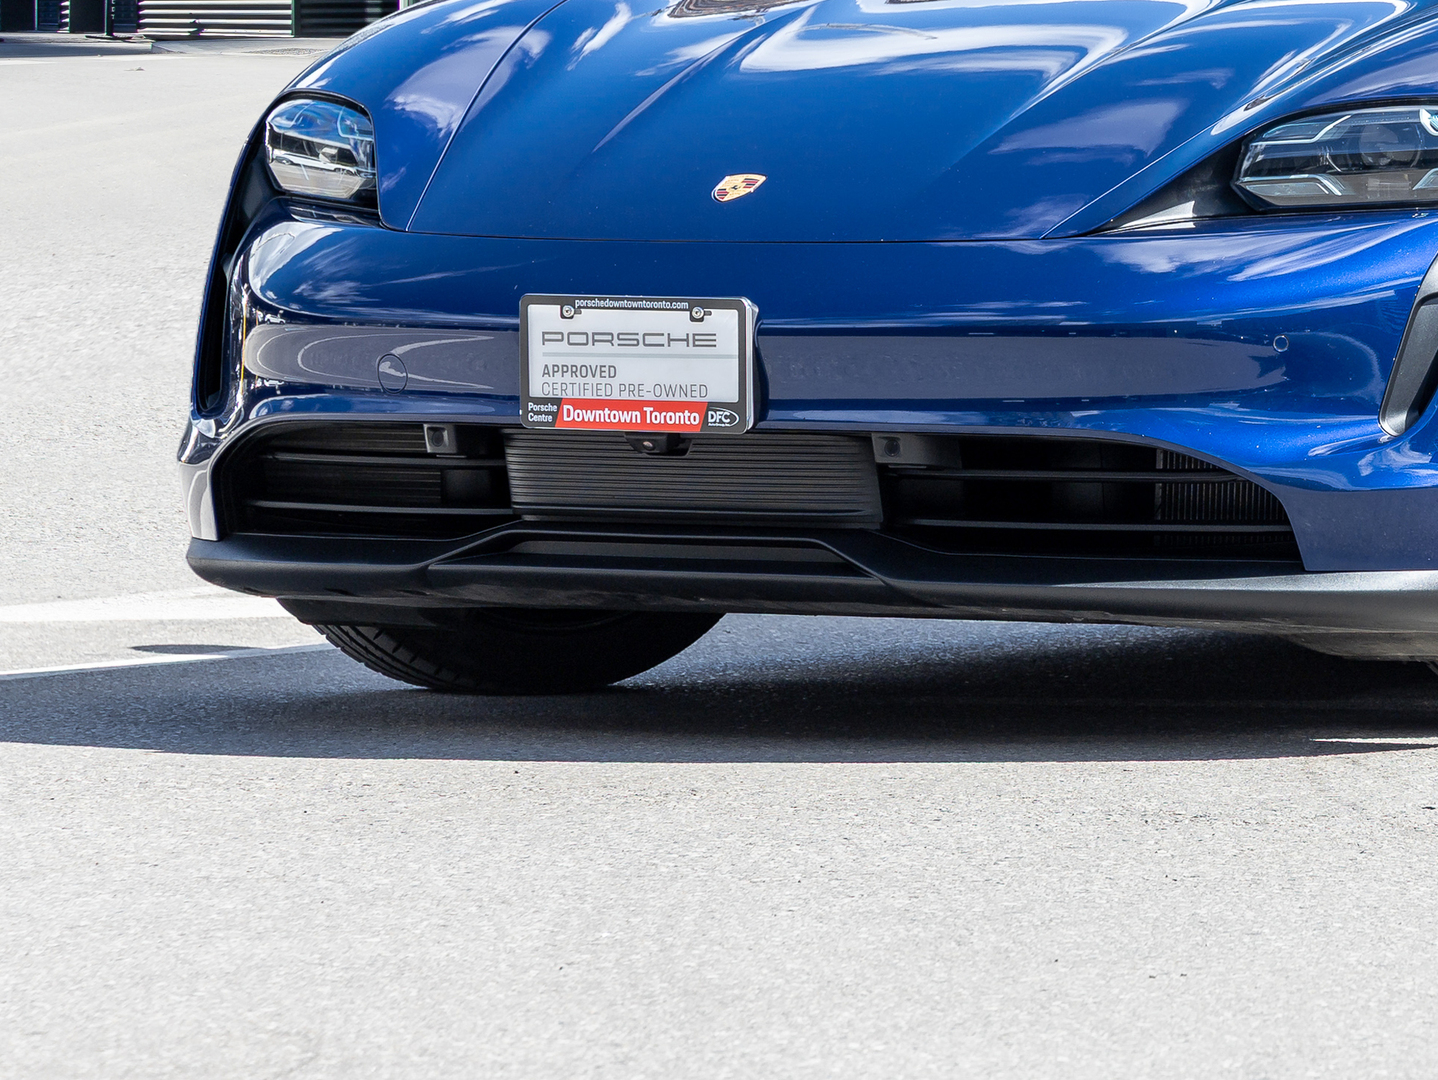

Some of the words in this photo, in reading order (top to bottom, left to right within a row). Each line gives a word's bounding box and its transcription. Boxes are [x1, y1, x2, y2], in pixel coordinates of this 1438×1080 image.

[574, 298, 689, 310] porschedowntowntoronto.com
[541, 331, 717, 348] PORSCHE
[541, 363, 617, 379] APPROVED
[541, 382, 613, 397] CERTIFIED
[619, 384, 708, 398] PRE-OWNED
[528, 402, 558, 412] Porsche
[528, 413, 553, 423] Centre
[562, 405, 641, 424] Downtown
[643, 407, 700, 426] Toronto
[708, 411, 731, 423] DFC
